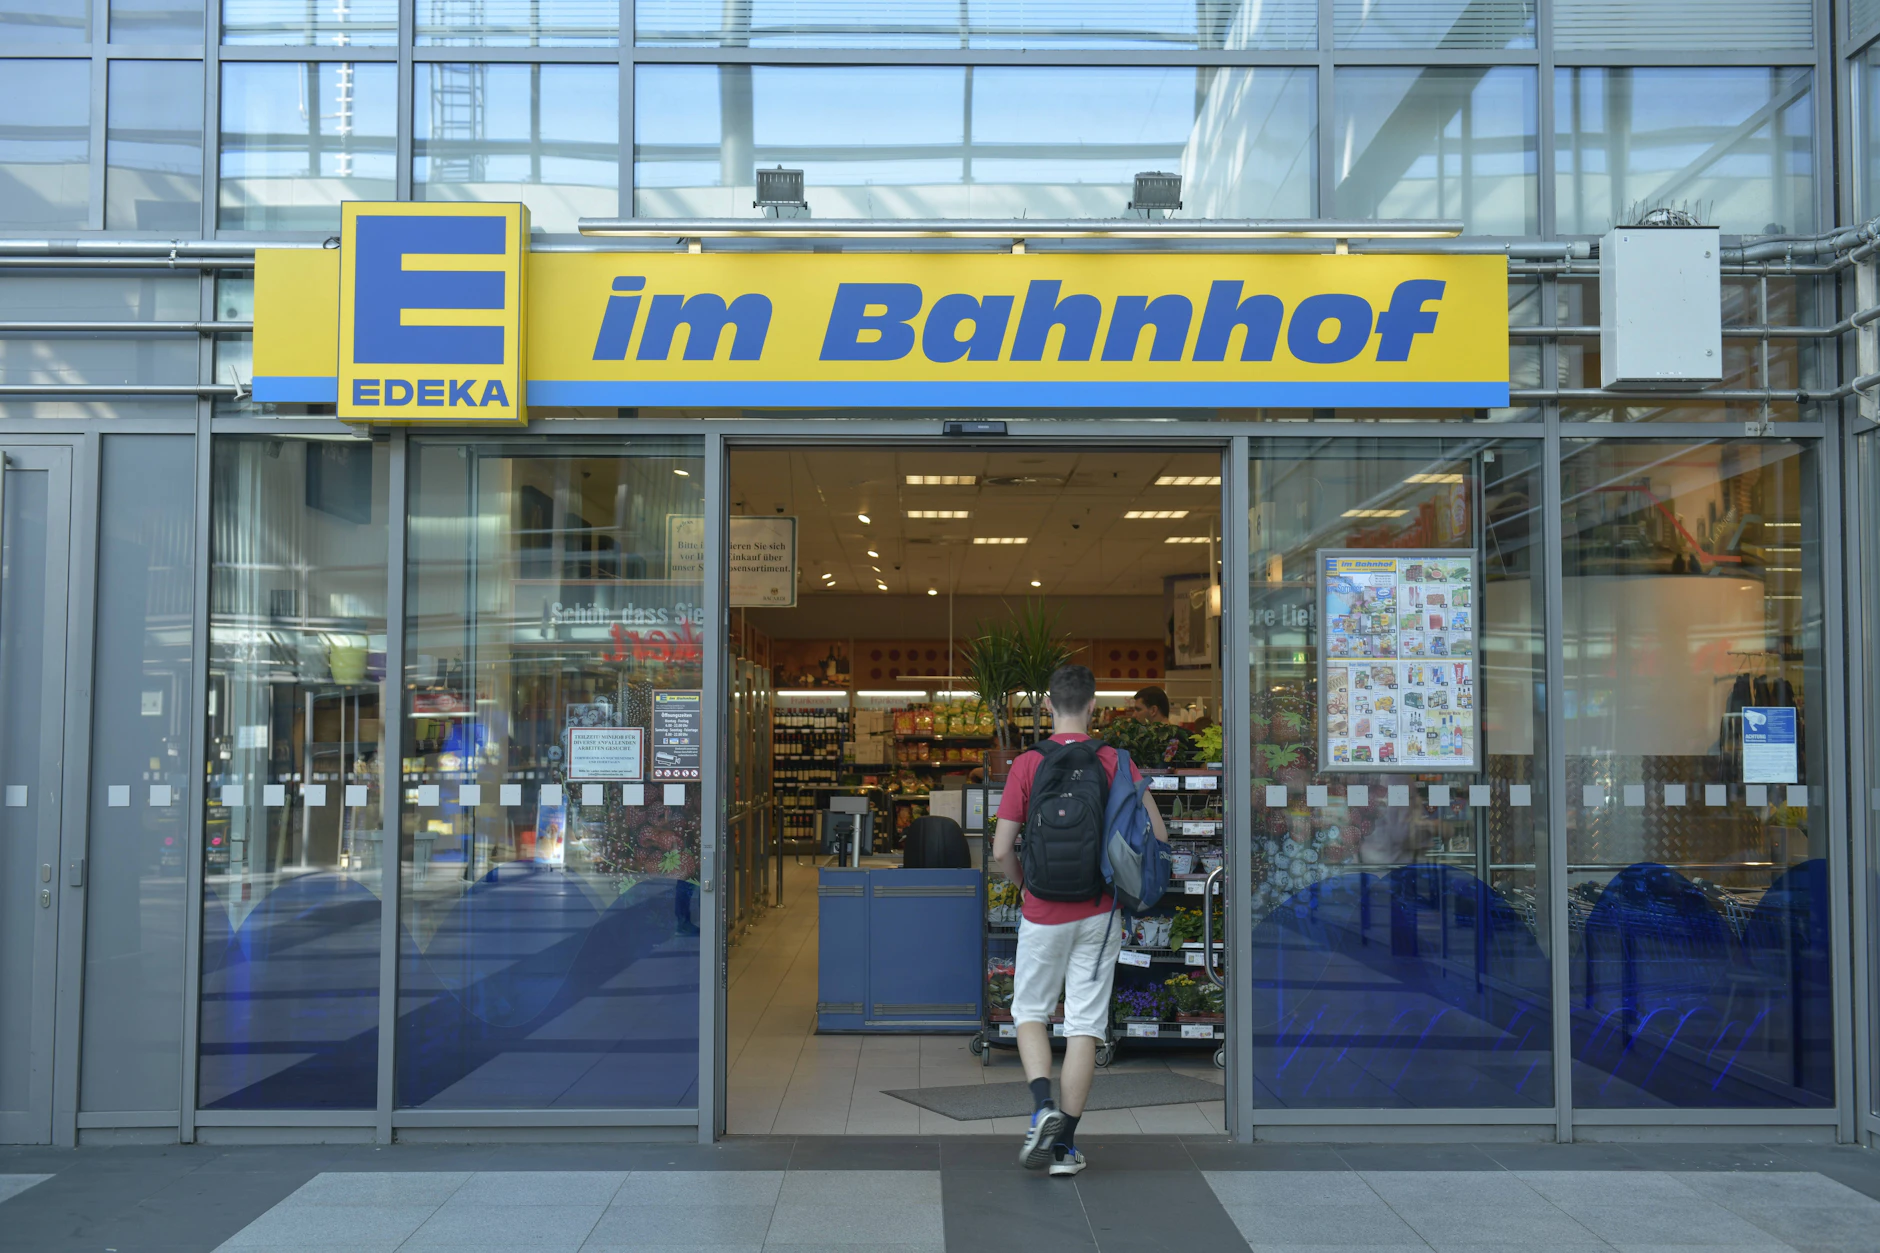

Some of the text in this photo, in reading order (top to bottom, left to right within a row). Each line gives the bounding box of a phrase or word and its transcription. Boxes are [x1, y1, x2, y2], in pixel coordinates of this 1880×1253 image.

[354, 216, 506, 364] E
[592, 275, 1446, 364] im Bahnhof
[352, 379, 509, 407] EDEKA
[677, 541, 698, 550] Bitte
[753, 542, 768, 551] Sie
[680, 553, 695, 561] vor
[622, 602, 668, 625] dass
[790, 696, 832, 705] Frankreich
[870, 696, 912, 705] Frankreich
